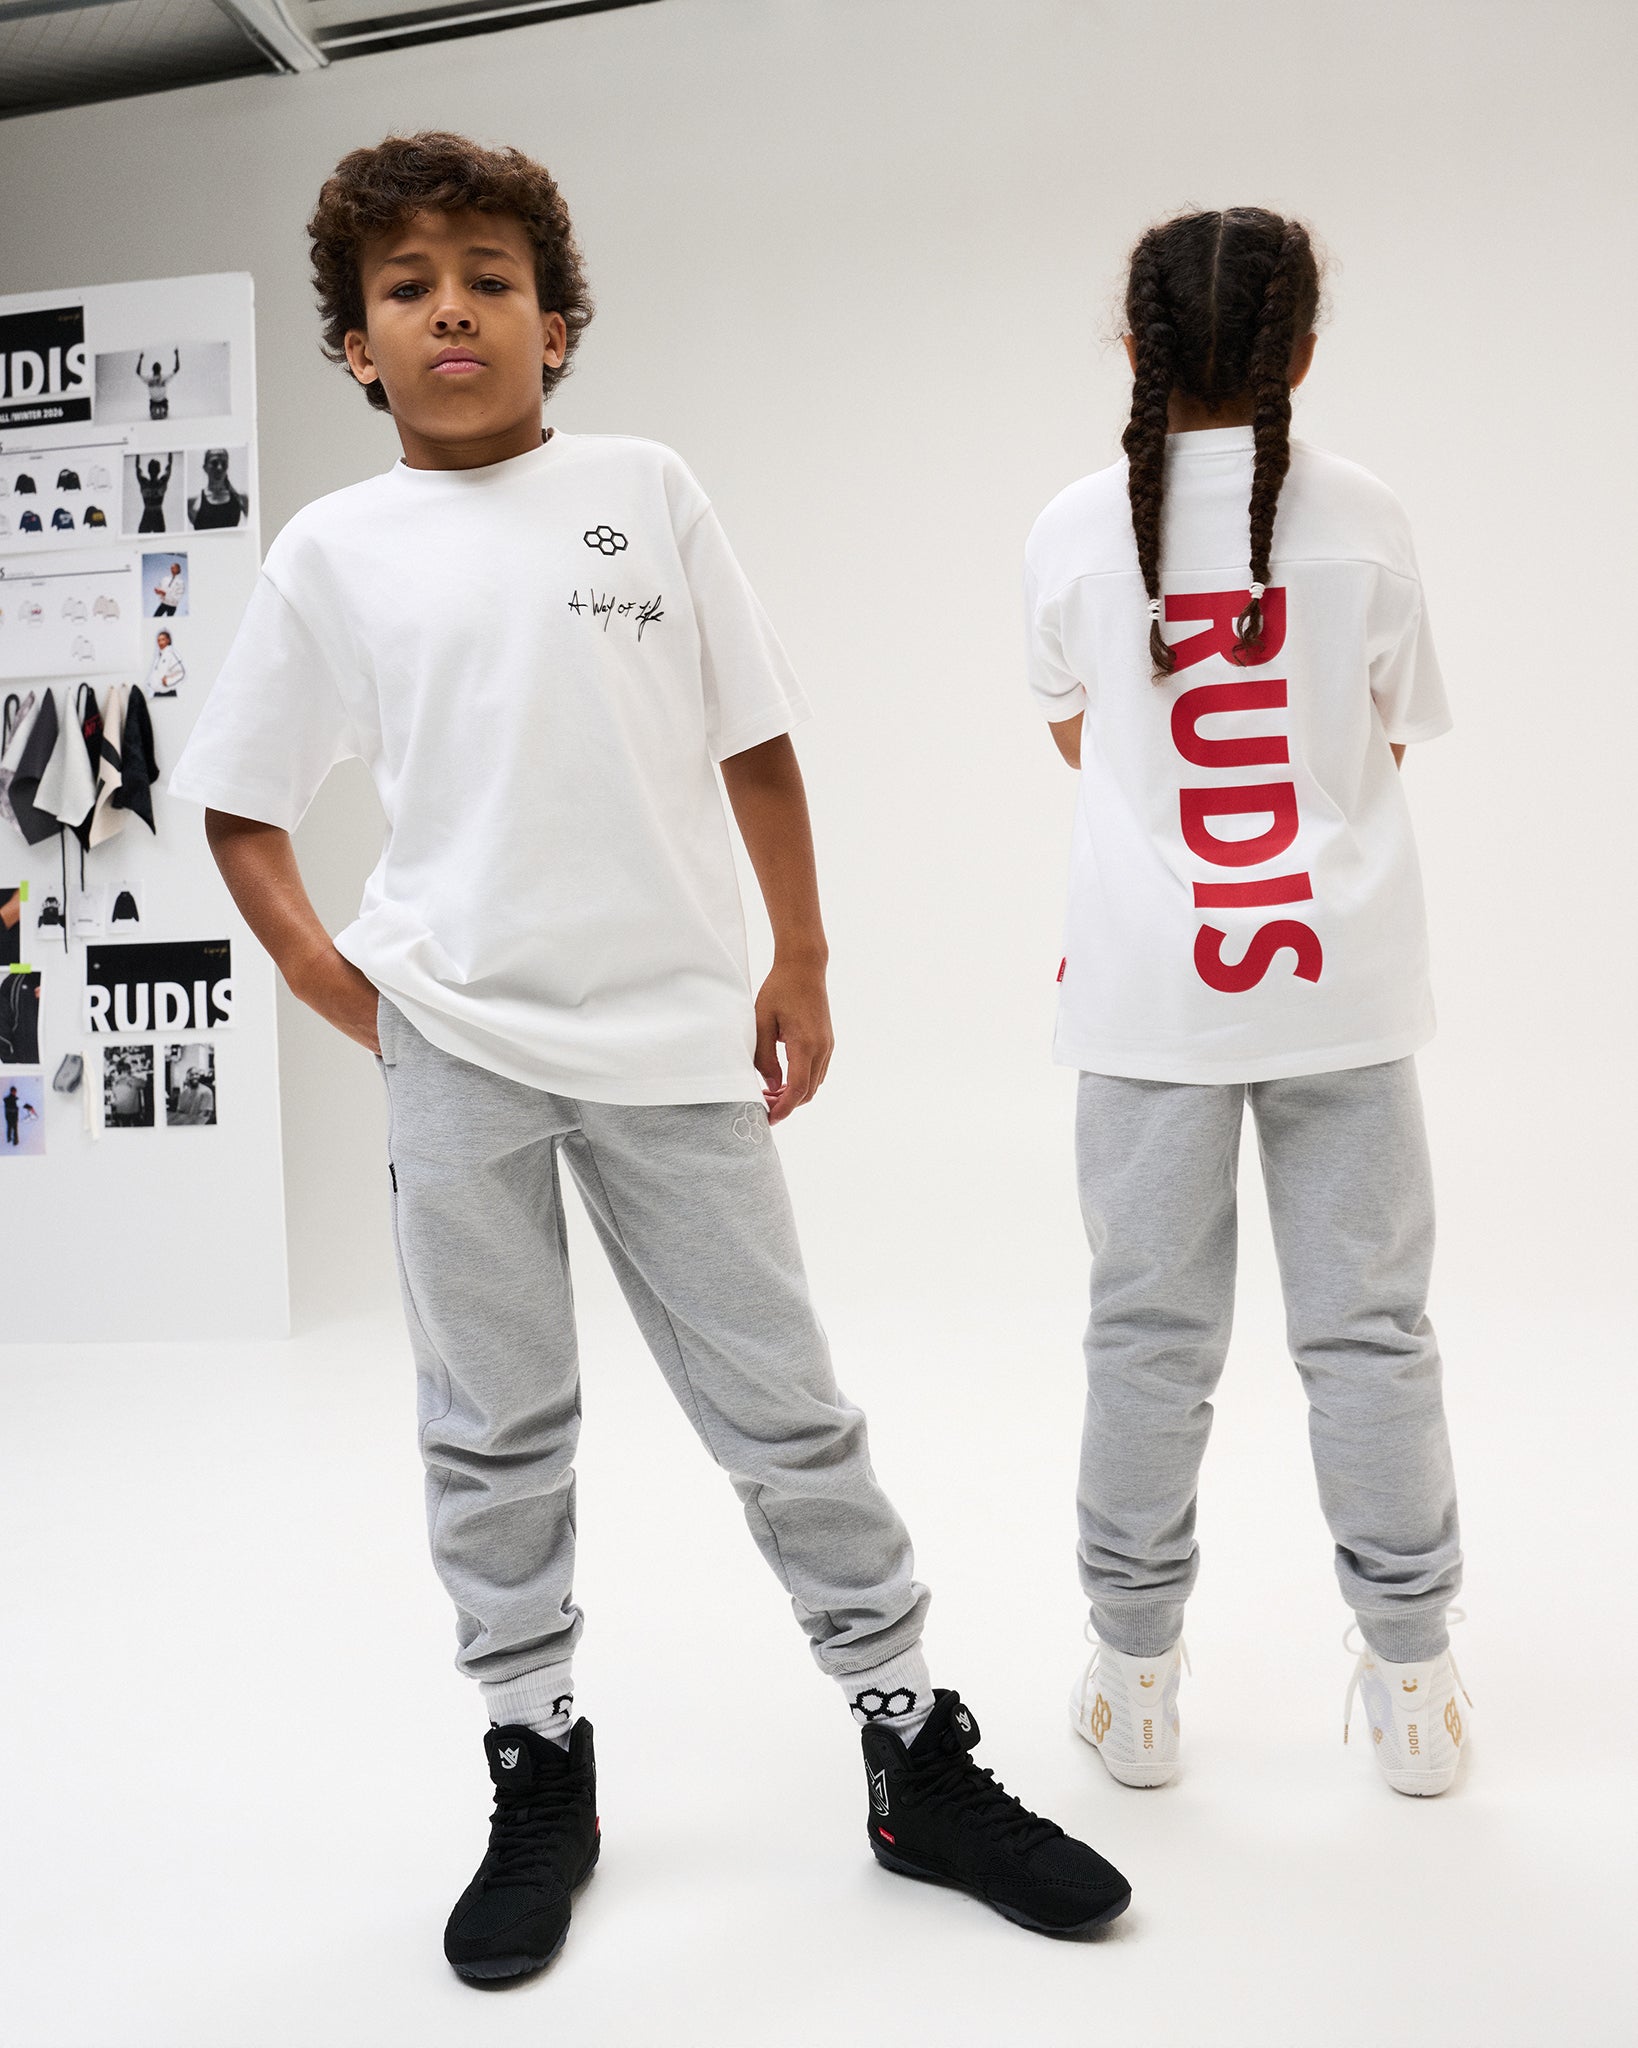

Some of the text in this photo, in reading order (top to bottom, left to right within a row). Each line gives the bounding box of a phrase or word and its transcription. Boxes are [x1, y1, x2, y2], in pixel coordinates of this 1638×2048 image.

[0, 342, 86, 398] DIS
[568, 590, 588, 615] A
[1164, 586, 1323, 994] RUDIS
[86, 977, 231, 1032] RUDIS
[1142, 1719, 1154, 1749] RUDIS
[1407, 1724, 1420, 1755] RUDIS
